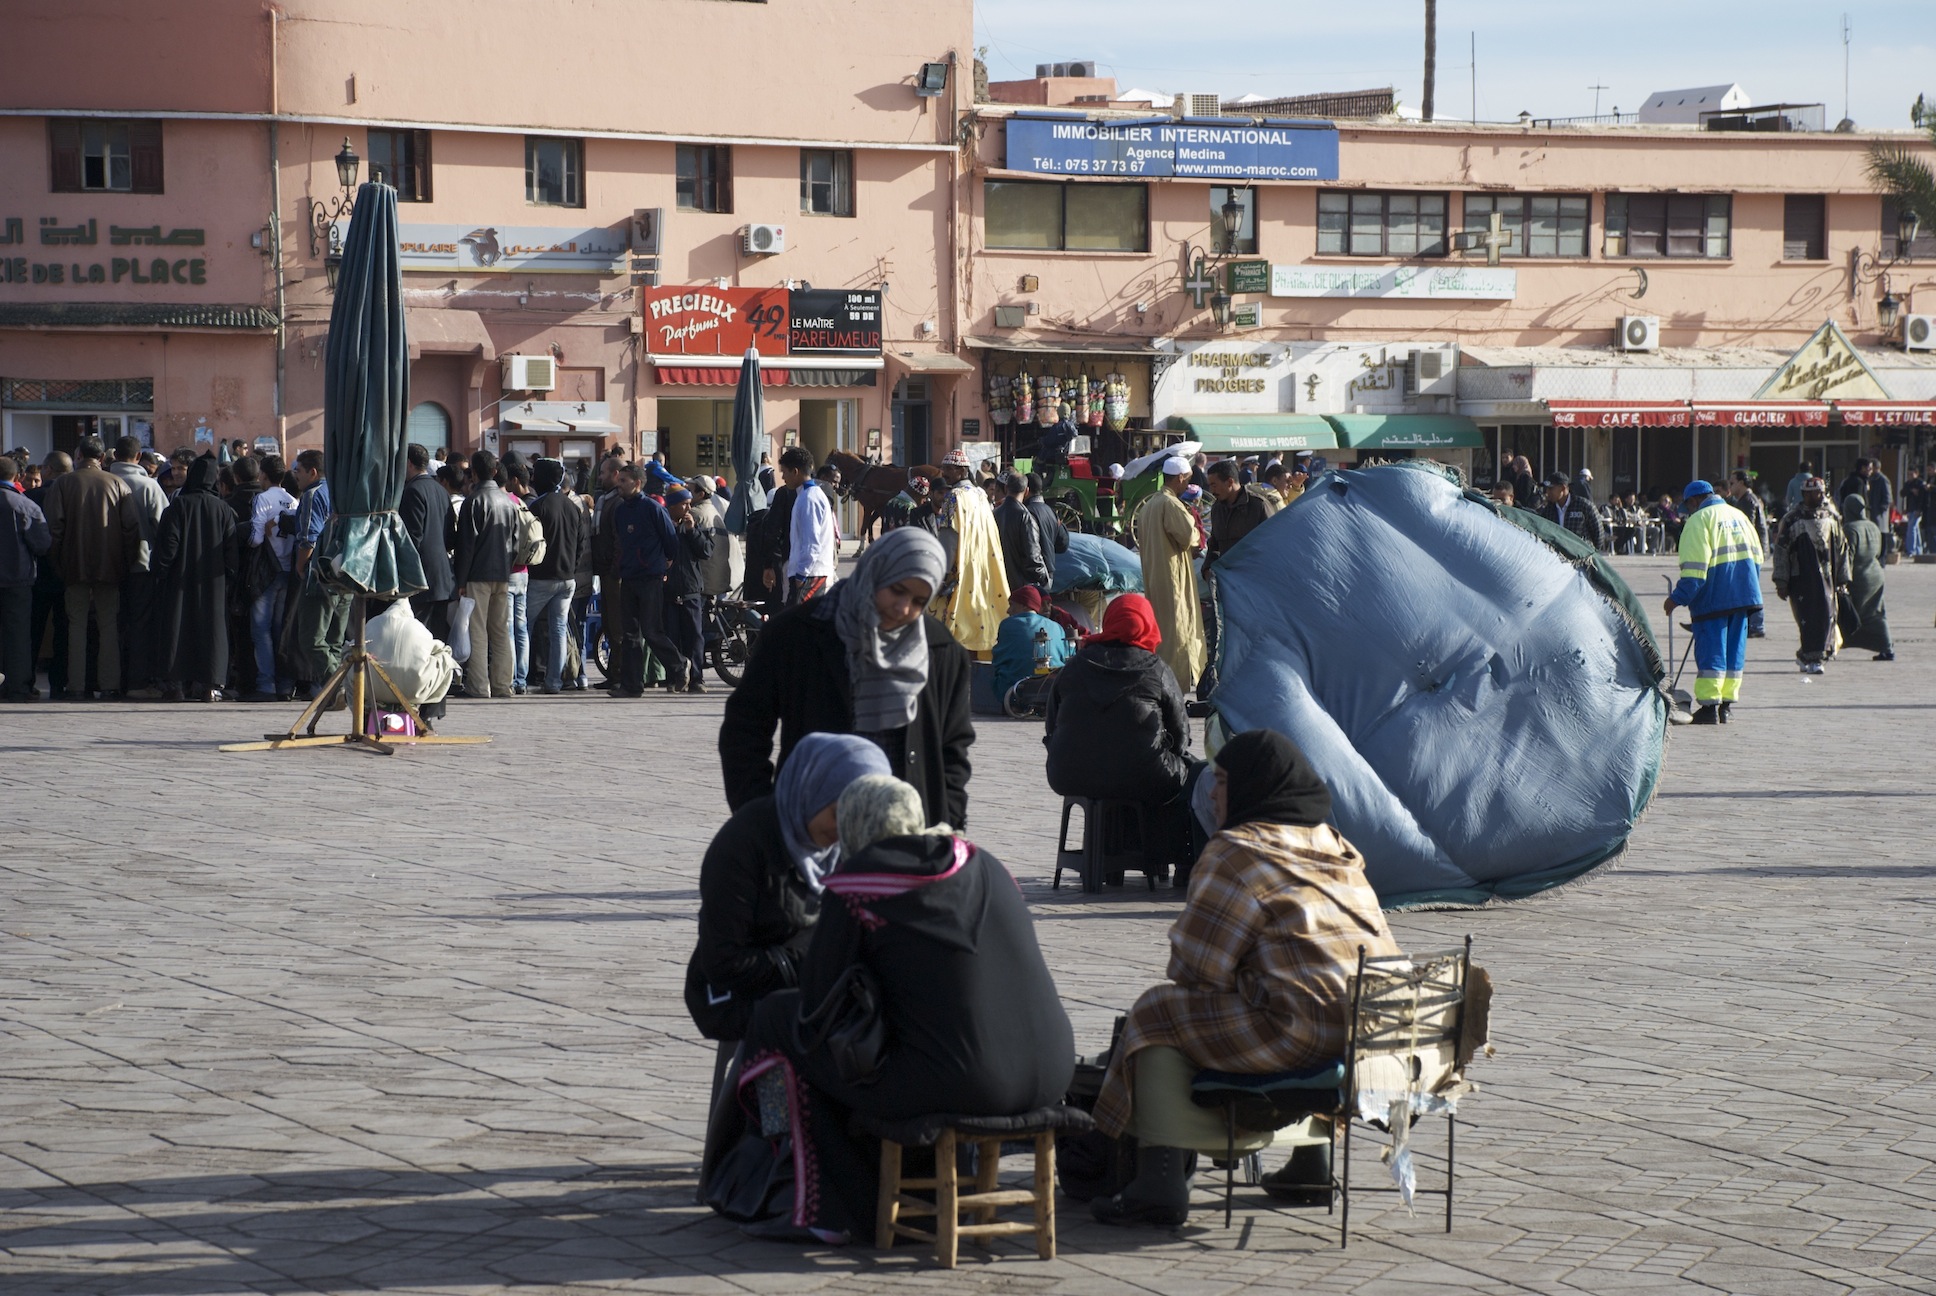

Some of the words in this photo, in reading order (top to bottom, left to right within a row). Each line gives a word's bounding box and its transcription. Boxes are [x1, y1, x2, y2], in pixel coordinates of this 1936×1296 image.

[1053, 125, 1152, 141] IMMOBILIER
[1160, 128, 1292, 145] INTERNATIONAL
[1126, 147, 1175, 161] Agence
[1179, 148, 1226, 160] Medina
[1033, 157, 1061, 170] Tél.:
[1092, 160, 1109, 171] 37
[1111, 160, 1127, 172] 73
[1130, 161, 1146, 172] 67
[1172, 164, 1318, 176] www.immo-maroc.com
[32, 263, 64, 284] DE
[72, 263, 106, 284] LA
[111, 257, 207, 285] PLACE
[848, 294, 862, 303] 100
[864, 294, 875, 303] ml
[650, 293, 737, 323] PRECIEUX
[746, 303, 785, 337] 49
[791, 318, 801, 328] LE
[803, 316, 834, 329] MAÎTRE
[849, 312, 860, 320] 59
[862, 312, 875, 320] DH
[660, 317, 719, 347] Parfums
[792, 330, 880, 347] PARFUMEUR
[1191, 352, 1271, 367] PHARMACIE
[1223, 366, 1240, 377] DU
[1196, 379, 1266, 392] PROGRES
[1733, 412, 1786, 423] GLACIER
[1874, 412, 1932, 422] L'ETOILE
[1230, 437, 1269, 448] PHARMACIE
[1277, 436, 1307, 447] PROGRES
